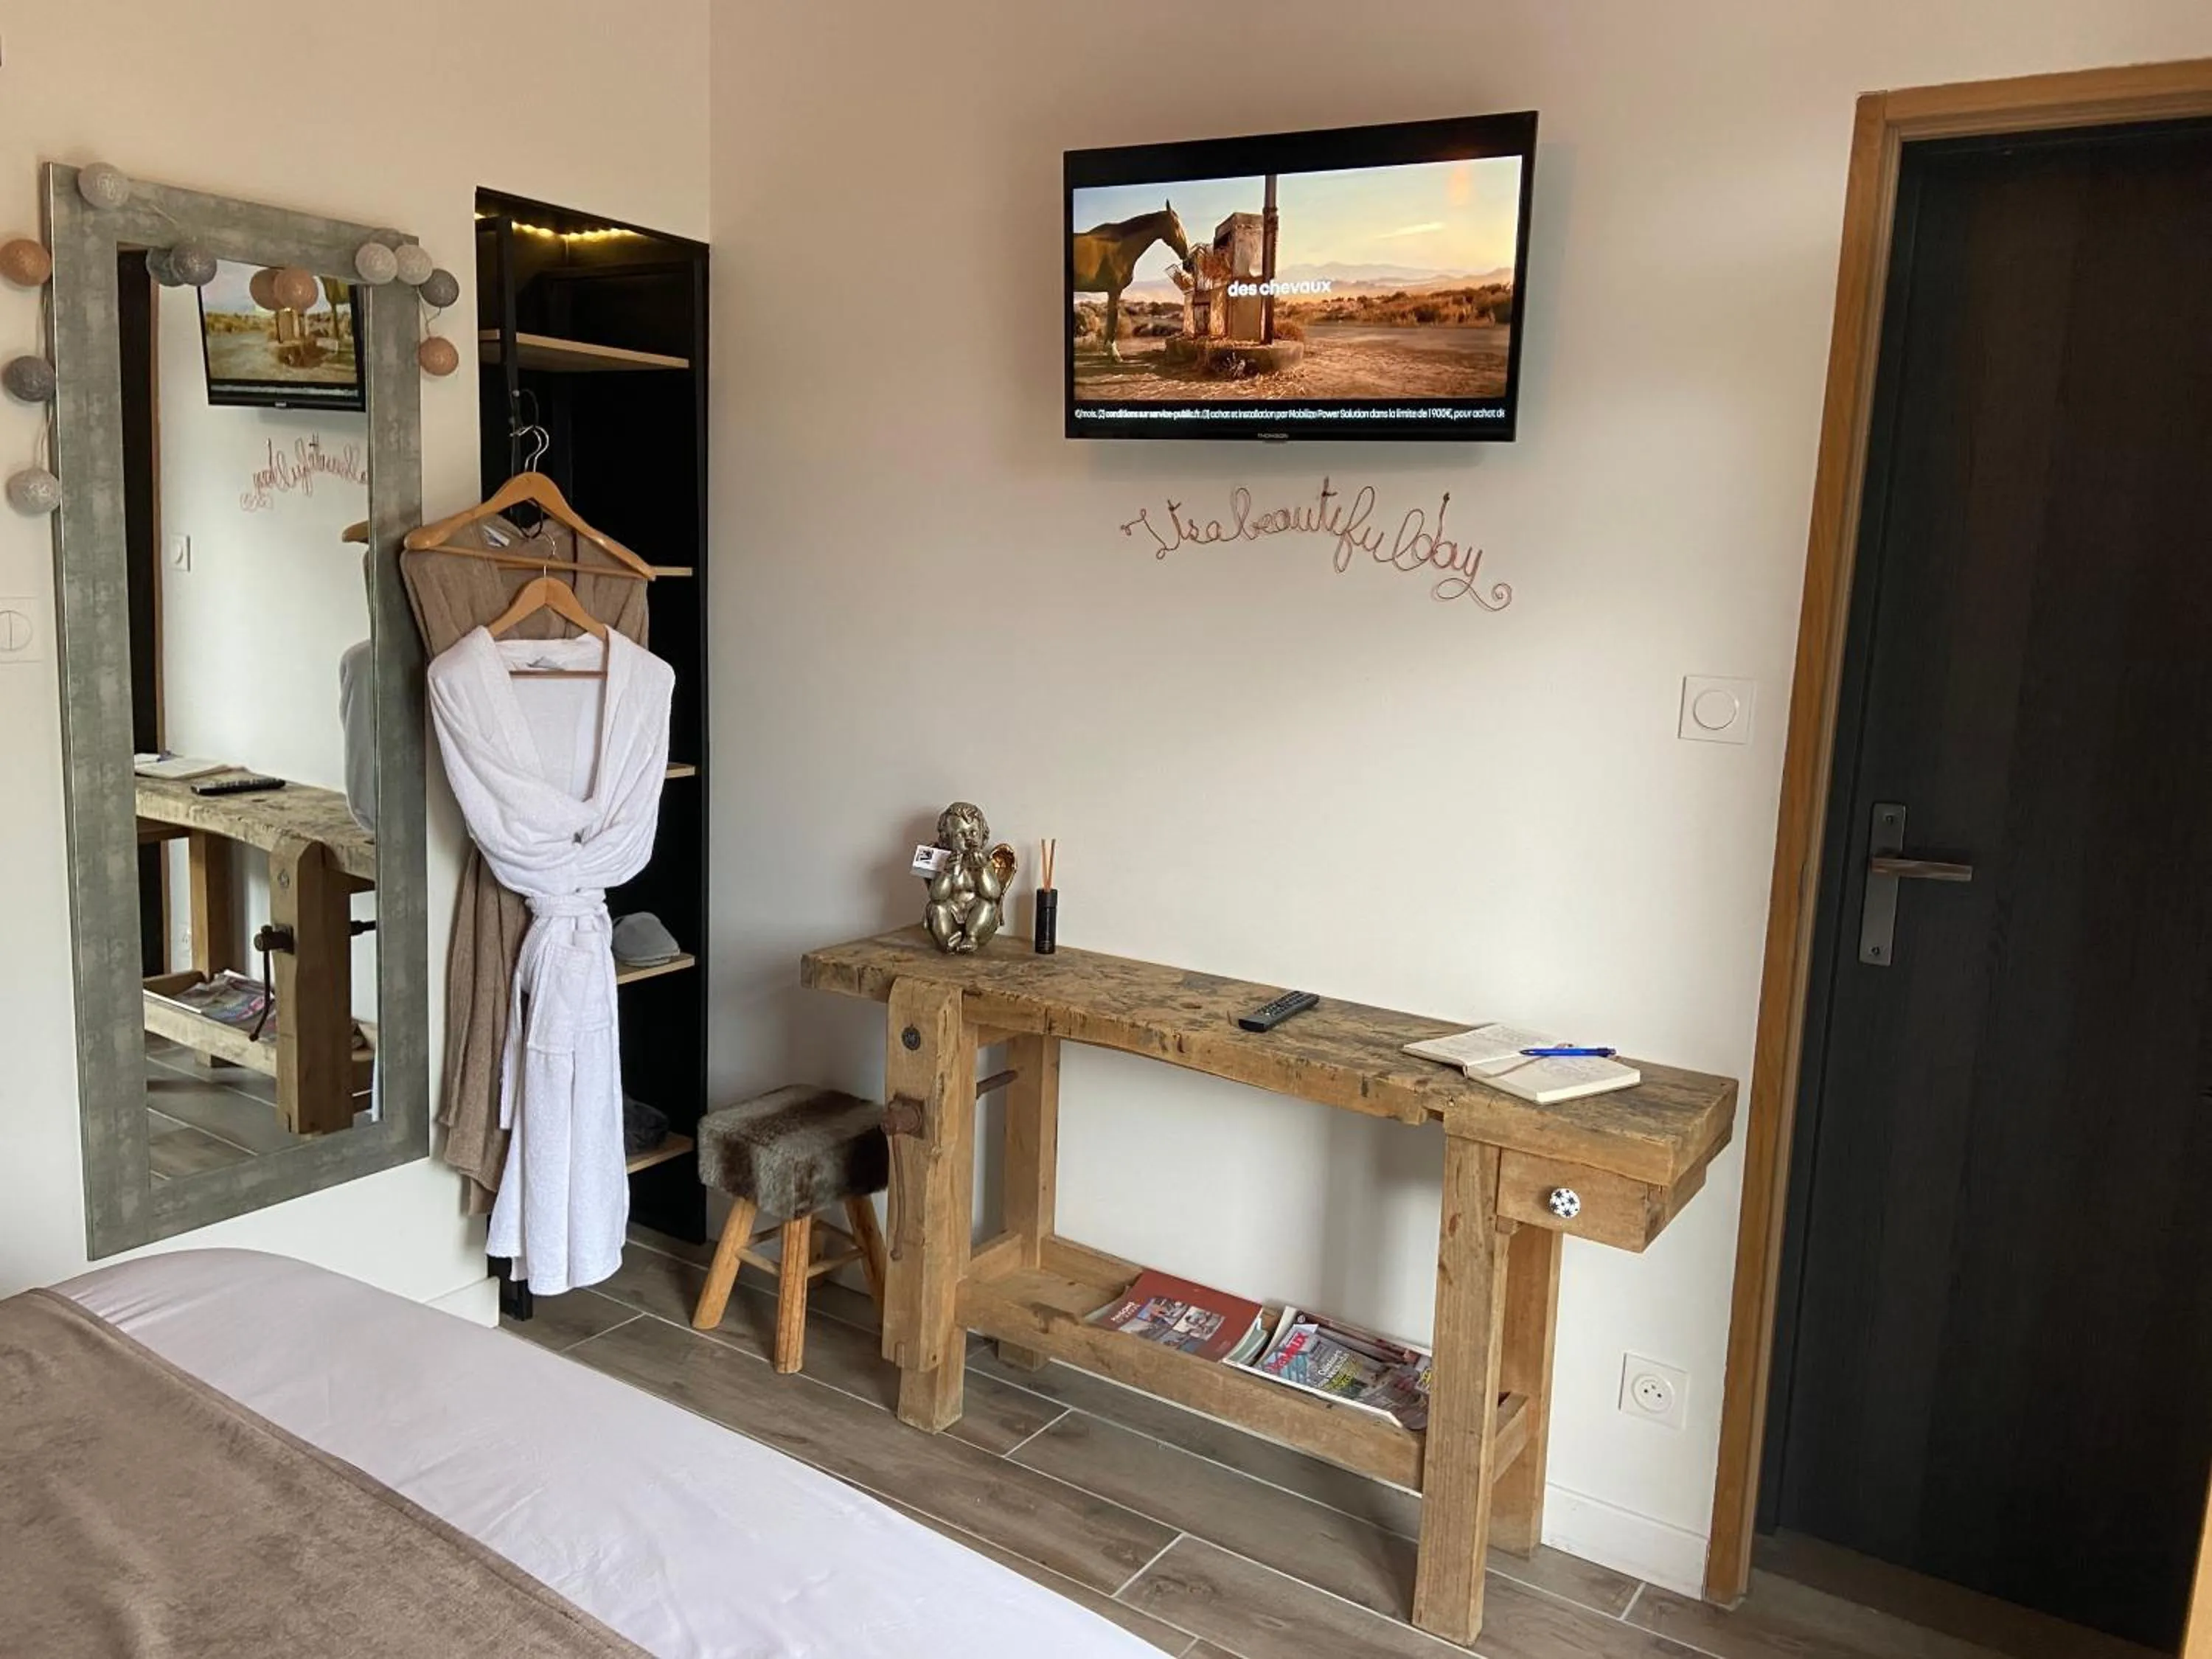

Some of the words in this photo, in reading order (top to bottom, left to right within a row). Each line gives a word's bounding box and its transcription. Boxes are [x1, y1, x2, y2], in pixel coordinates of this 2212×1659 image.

[1228, 280, 1257, 297] des
[1259, 278, 1332, 296] chevaux
[1317, 409, 1340, 418] Power
[1340, 408, 1369, 418] Solution
[1370, 408, 1388, 418] dans
[1388, 408, 1396, 418] la
[1397, 408, 1416, 418] limite
[1417, 408, 1427, 418] de
[1453, 410, 1472, 421] pour
[1472, 408, 1496, 418] achat
[1234, 475, 1425, 573] beautiful
[1413, 492, 1512, 611] day
